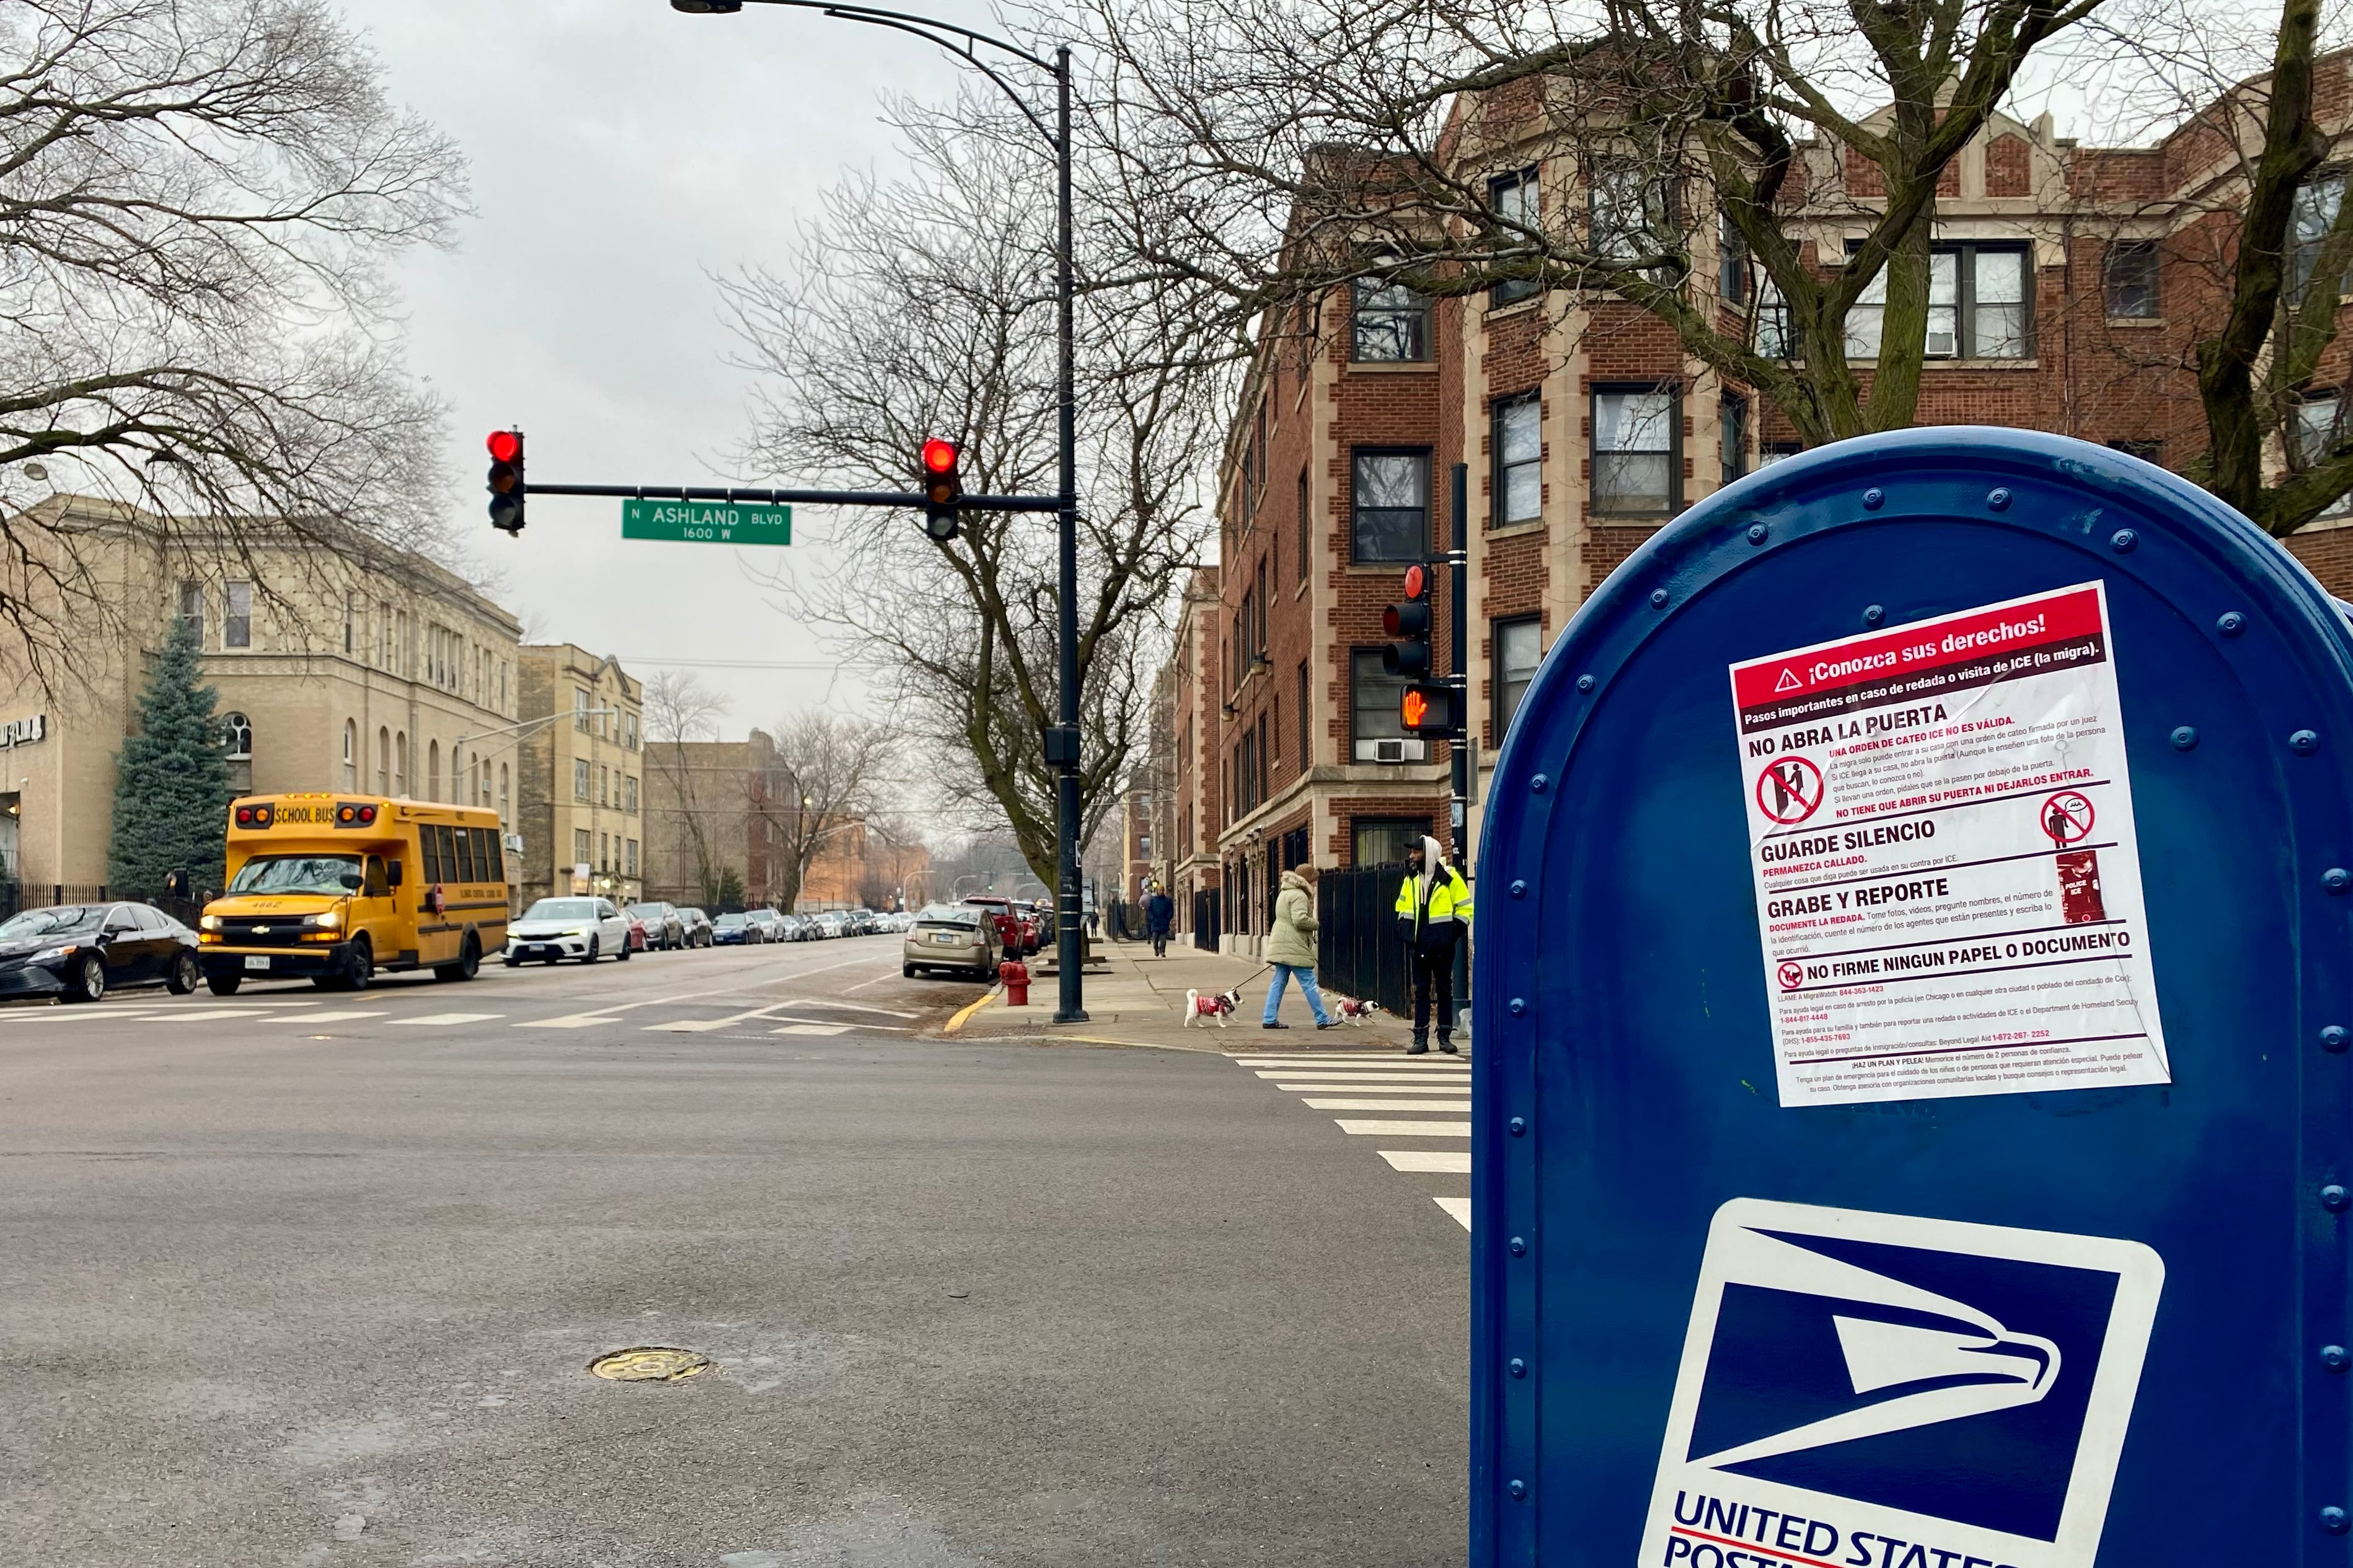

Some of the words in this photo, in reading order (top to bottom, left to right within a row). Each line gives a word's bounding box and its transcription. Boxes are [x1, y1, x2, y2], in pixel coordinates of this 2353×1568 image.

[632, 508, 640, 519] N
[652, 507, 739, 526] ASHLAND
[751, 513, 783, 526] BLVD
[684, 527, 713, 539] 1600
[722, 529, 731, 540] W
[1808, 651, 1897, 685] ¡Conozca
[1902, 643, 1937, 662] sus
[1941, 613, 2046, 653] derechos!
[1744, 711, 1777, 725] Pasos
[1778, 697, 1843, 718] importantes
[1845, 694, 1859, 704] en
[1860, 687, 1887, 700] caso
[1889, 683, 1904, 695] de
[1905, 674, 1946, 692] redada
[1948, 674, 1956, 683] o
[1957, 666, 1991, 680] visita
[1993, 661, 2010, 674] de
[2010, 655, 2033, 671] ICE
[2034, 652, 2051, 667] (la
[2053, 641, 2099, 661] migra).
[1749, 738, 1775, 758] NO
[1781, 726, 1834, 752] ABRA
[1837, 720, 1862, 740] LA
[1865, 703, 1948, 734] PUERTA
[1829, 747, 1848, 758] UNA
[1848, 741, 1880, 754] ORDEN
[1881, 738, 1894, 748] DE
[1896, 732, 1927, 746] CATEO
[1928, 729, 1944, 739] ICE
[1945, 726, 1959, 736] NO
[1961, 723, 1975, 733] ES
[1976, 716, 2015, 730] VÁLIDA.
[1829, 762, 1839, 770] La
[1839, 759, 1858, 769] migra
[1858, 756, 1872, 765] solo
[1873, 752, 1894, 764] puede
[1894, 749, 1914, 758] entrar
[1930, 743, 1945, 752] casa
[1945, 740, 1959, 751] con
[1960, 738, 1974, 746] una
[1975, 734, 1996, 744] orden
[1997, 731, 2006, 739] de
[2007, 728, 2028, 738] cateo
[2028, 722, 2055, 734] firmada
[2056, 720, 2068, 730] por
[2081, 715, 2098, 726] juez
[1830, 773, 1839, 782] Si
[1839, 770, 1851, 780] ICE
[1850, 769, 1868, 778] llega
[1883, 764, 1900, 772] casa,
[1910, 759, 1925, 767] abra
[1926, 756, 1933, 764] la
[1933, 751, 1956, 764] puerta
[1955, 748, 1987, 760] (Aunque
[1987, 745, 1995, 753] le
[1995, 741, 2025, 752] enseñen
[2026, 738, 2040, 746] una
[2040, 734, 2054, 744] foto
[2055, 733, 2065, 741] de
[2066, 731, 2074, 739] la
[2075, 727, 2106, 739] persona
[1832, 785, 1845, 793] que
[1845, 780, 1871, 790] buscan,
[1879, 774, 1906, 785] conozca
[1912, 769, 1925, 779] no).
[1835, 808, 1849, 819] NO
[1850, 803, 1877, 816] TIENE
[1878, 800, 1897, 812] QUE
[1899, 795, 1927, 808] ABRIR
[1928, 793, 1941, 803] SU
[1943, 786, 1982, 800] PUERTA
[1984, 784, 1995, 794] NI
[1996, 775, 2047, 792] DEJARLOS
[2049, 768, 2094, 783] ENTRAR.
[275, 807, 312, 823] SCHOOL
[316, 807, 335, 823] BUS
[1761, 834, 1840, 863] GUARDE
[1843, 819, 1935, 850] SILENCIO
[1762, 861, 1822, 878] PERMANEZCA
[1824, 855, 1868, 868] CALLADO.
[1764, 879, 1793, 889] Cualquier
[1794, 877, 1809, 885] cosa
[1810, 875, 1822, 884] que
[1822, 873, 1837, 881] diga
[1837, 869, 1858, 880] puede
[1870, 865, 1890, 874] usada
[1909, 859, 1931, 868] contra
[1932, 858, 1944, 866] por
[1945, 854, 1959, 863] ICE.
[2065, 879, 2088, 890] POLICE
[1767, 894, 1832, 918] GRABE
[1835, 891, 1850, 909] Y
[1855, 878, 1949, 907] REPORTE
[2070, 888, 2082, 896] ICE
[1769, 919, 1817, 933] DOCUMENTE
[1818, 917, 1829, 927] LA
[1830, 913, 1866, 925] REDADA.
[1866, 912, 1887, 920] Tome
[1887, 909, 1908, 917] fotos,
[1935, 901, 1967, 913] pregunte
[1969, 897, 2003, 907] nombres,
[2004, 894, 2011, 902] el
[2013, 892, 2042, 901] número
[2043, 889, 2053, 897] de
[1770, 936, 1777, 945] la
[1778, 931, 1824, 943] identificación,
[1824, 928, 1848, 938] cuente
[1848, 927, 1855, 935] el
[1856, 923, 1883, 934] número
[1883, 922, 1893, 931] de
[1894, 921, 1905, 929] los
[1905, 918, 1935, 929] agentes
[1935, 917, 1949, 926] que
[1950, 912, 1971, 922] están
[1972, 909, 2008, 922] presentes
[2009, 909, 2015, 917] y
[2015, 904, 2044, 914] escriba
[2044, 902, 2052, 910] lo
[1772, 949, 1785, 958] que
[1785, 944, 1811, 955] ocurrió.
[1807, 964, 1829, 980] NO
[1832, 958, 1880, 977] FIRME
[1883, 951, 1945, 972] NINGUN
[1948, 945, 2002, 965] PAPEL
[2005, 943, 2018, 958] O
[1777, 993, 1798, 1002] LLAME
[1803, 990, 1839, 1001] MigraWatch:
[1839, 985, 1884, 997] 844-363-1423
[1780, 1013, 1829, 1024] 1-844-817-4448
[2031, 1029, 2051, 1038] 2252
[1801, 1033, 1851, 1044] 1-855-435-7693
[1674, 1491, 1839, 1557] UNITED
[1845, 1531, 2015, 1568] STAT
